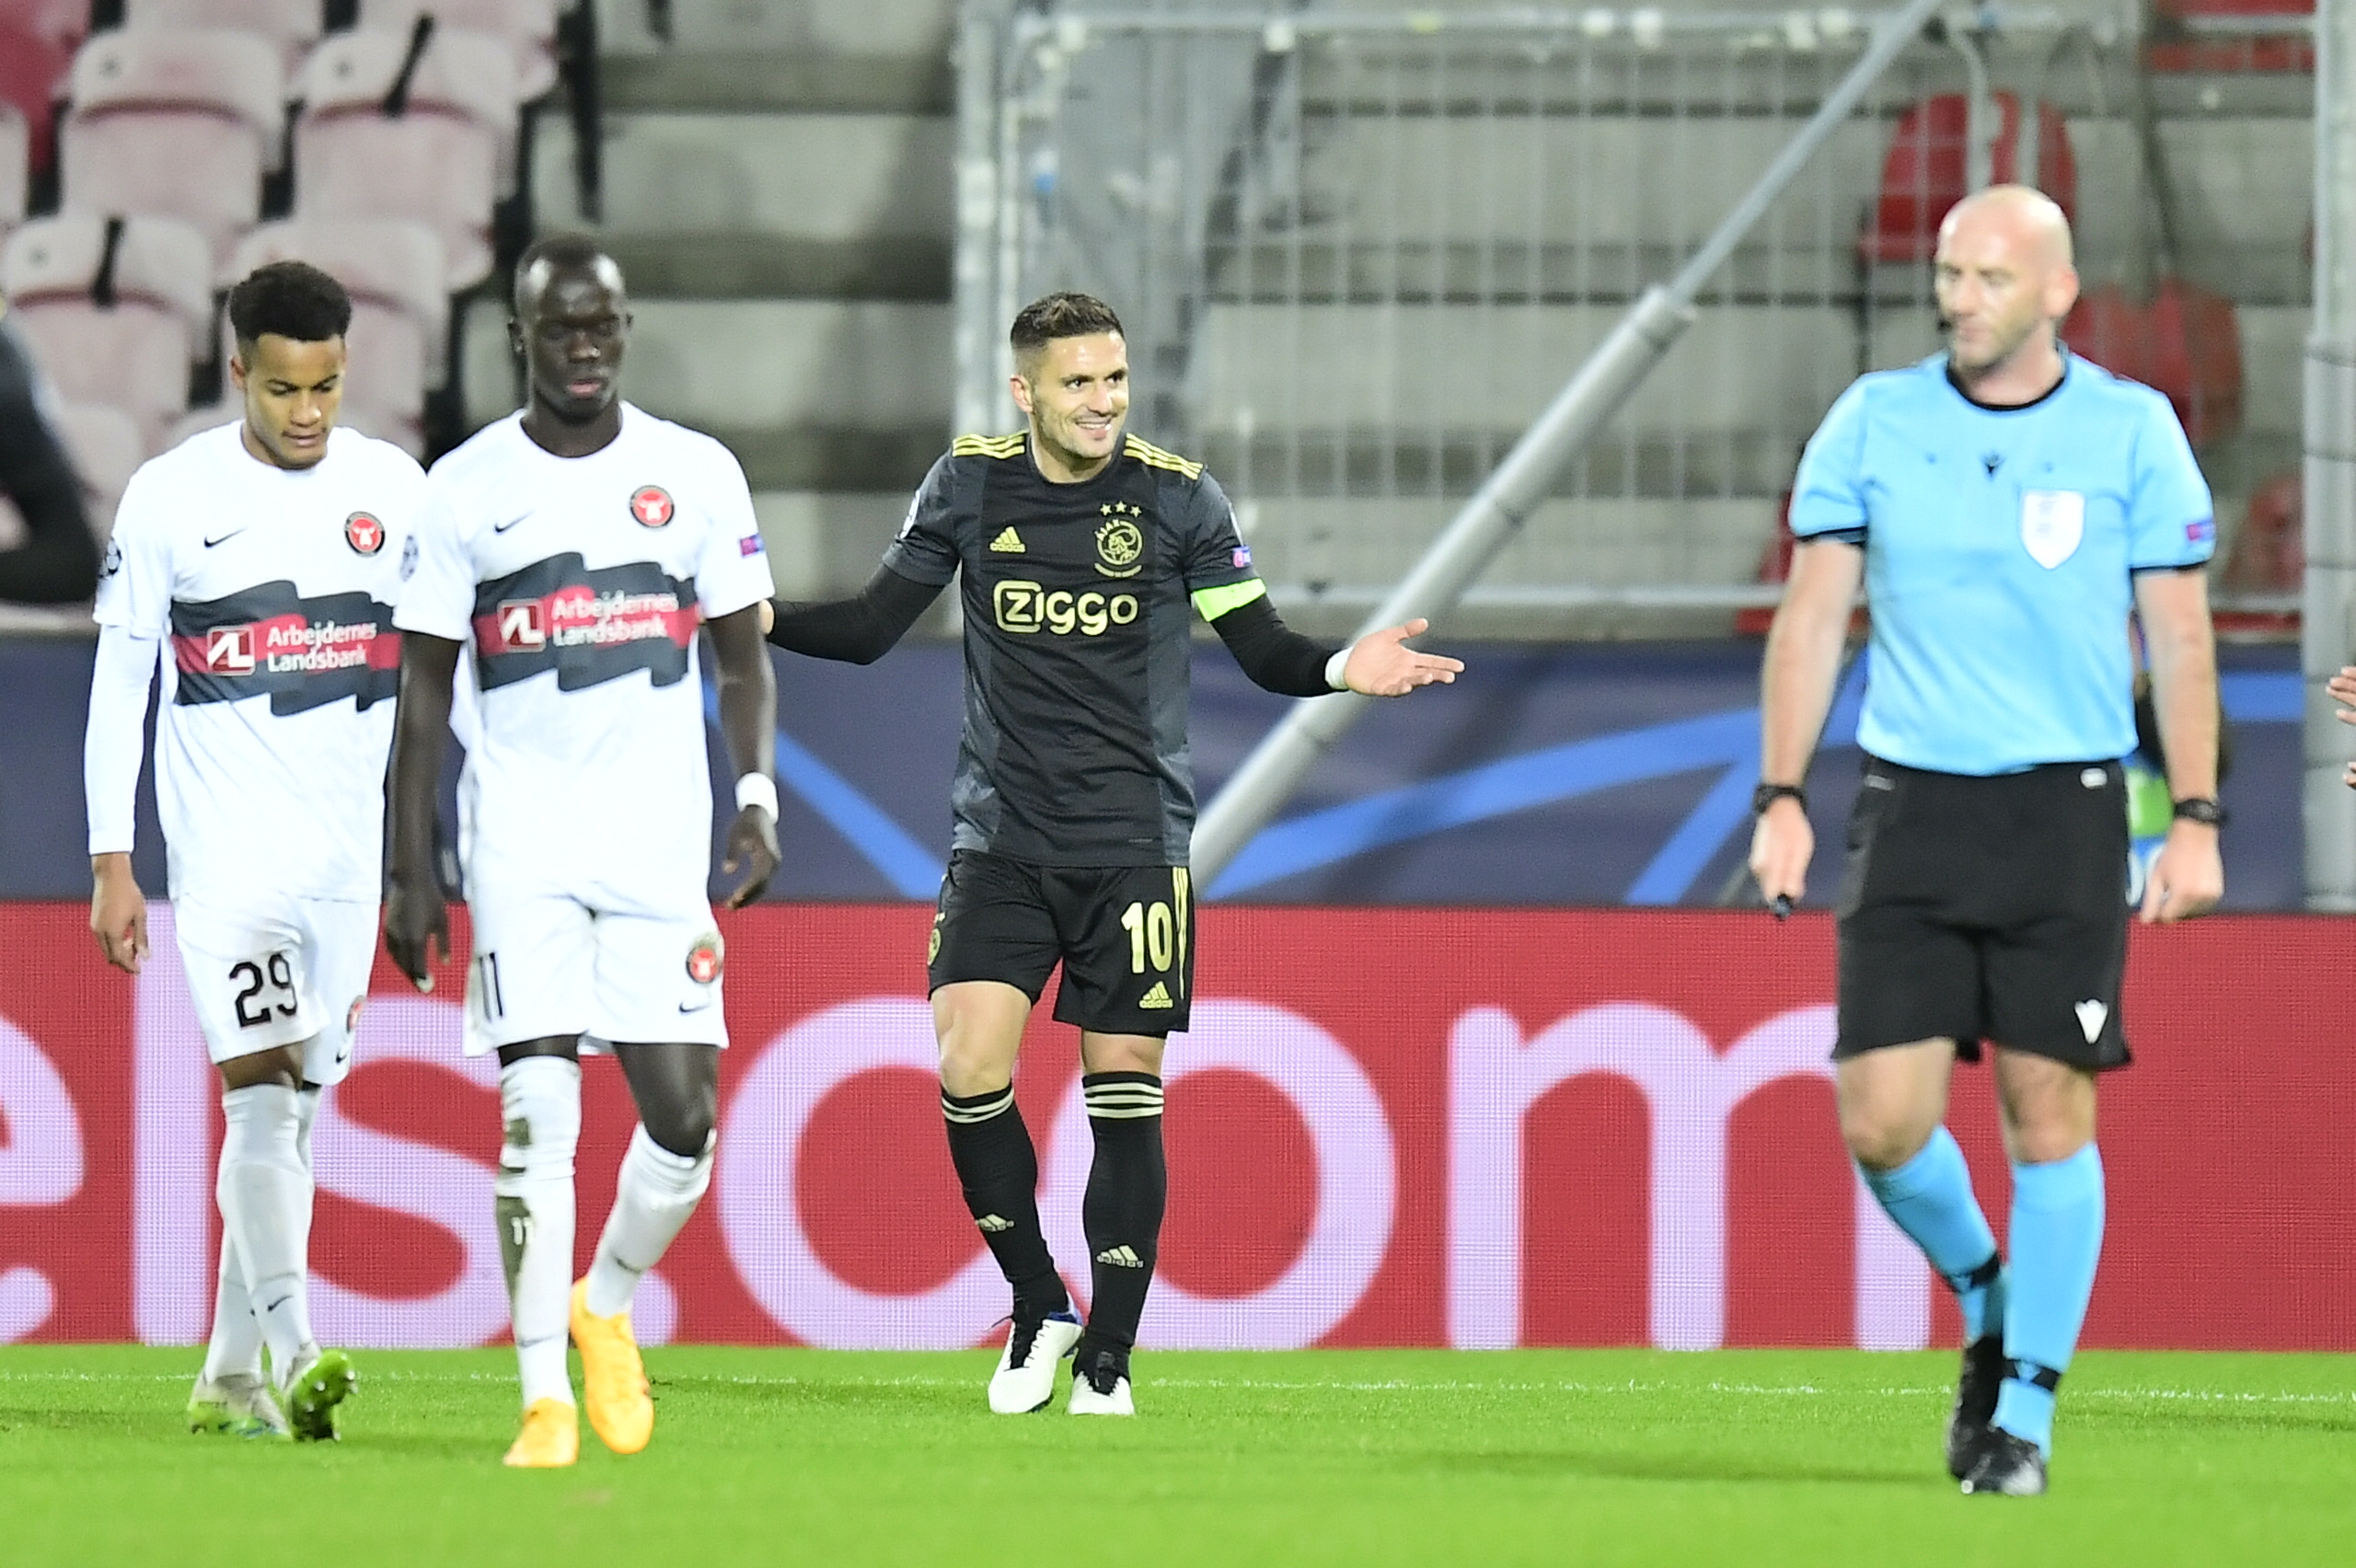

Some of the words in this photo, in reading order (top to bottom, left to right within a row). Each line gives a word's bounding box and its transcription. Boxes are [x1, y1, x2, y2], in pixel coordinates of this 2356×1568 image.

[552, 589, 679, 621] Arbejdernes
[994, 580, 1138, 636] Ziggo
[266, 619, 377, 648] Arbejdernes
[553, 614, 667, 647] Landsbank
[267, 643, 367, 673] Landsbank
[1121, 901, 1173, 974] 10
[229, 952, 297, 1029] 29
[0, 903, 1931, 1349] ls.com
